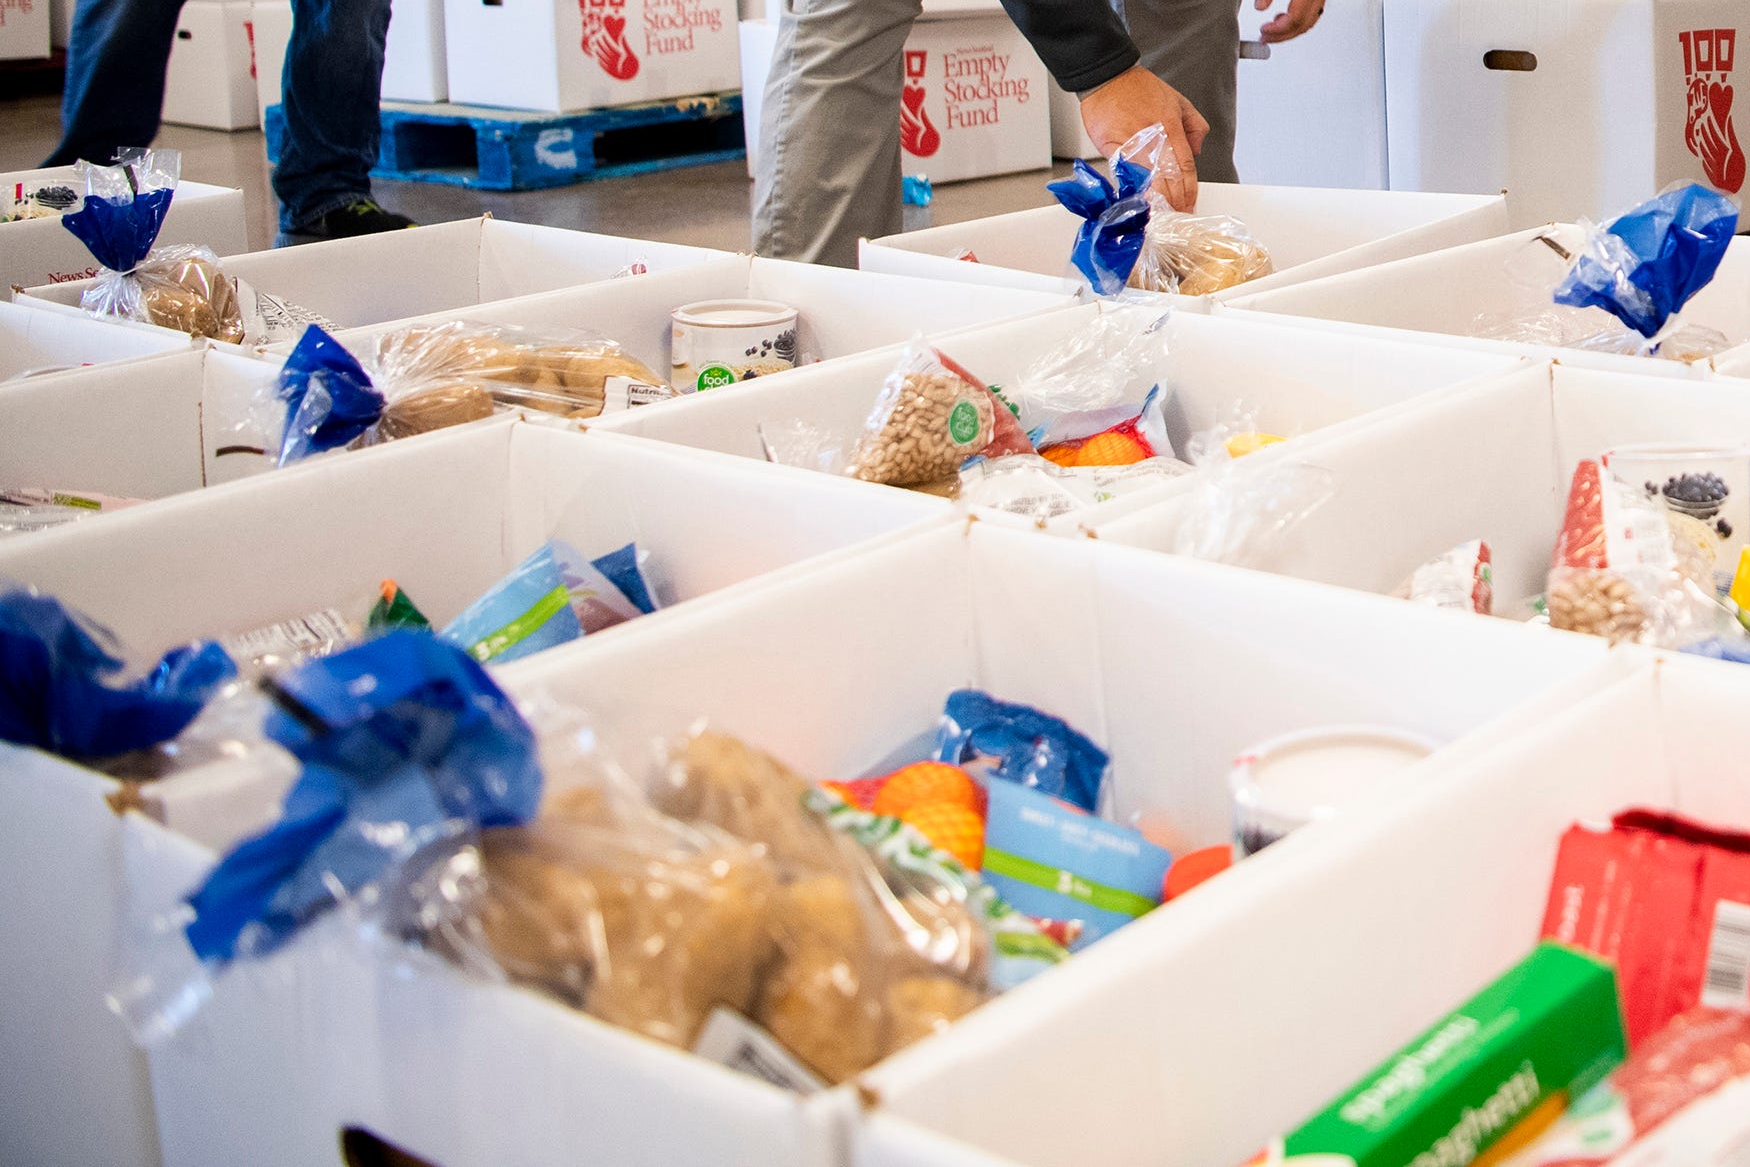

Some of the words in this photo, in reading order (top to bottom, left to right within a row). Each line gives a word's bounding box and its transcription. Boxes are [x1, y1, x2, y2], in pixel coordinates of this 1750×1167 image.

[643, 7, 722, 32] Stocking
[645, 28, 695, 55] Fund
[1679, 29, 1736, 75] 100
[944, 52, 1010, 81] Empty
[945, 74, 1030, 103] Stocking
[947, 99, 998, 129] Fund
[47, 270, 85, 284] News
[703, 373, 730, 386] food
